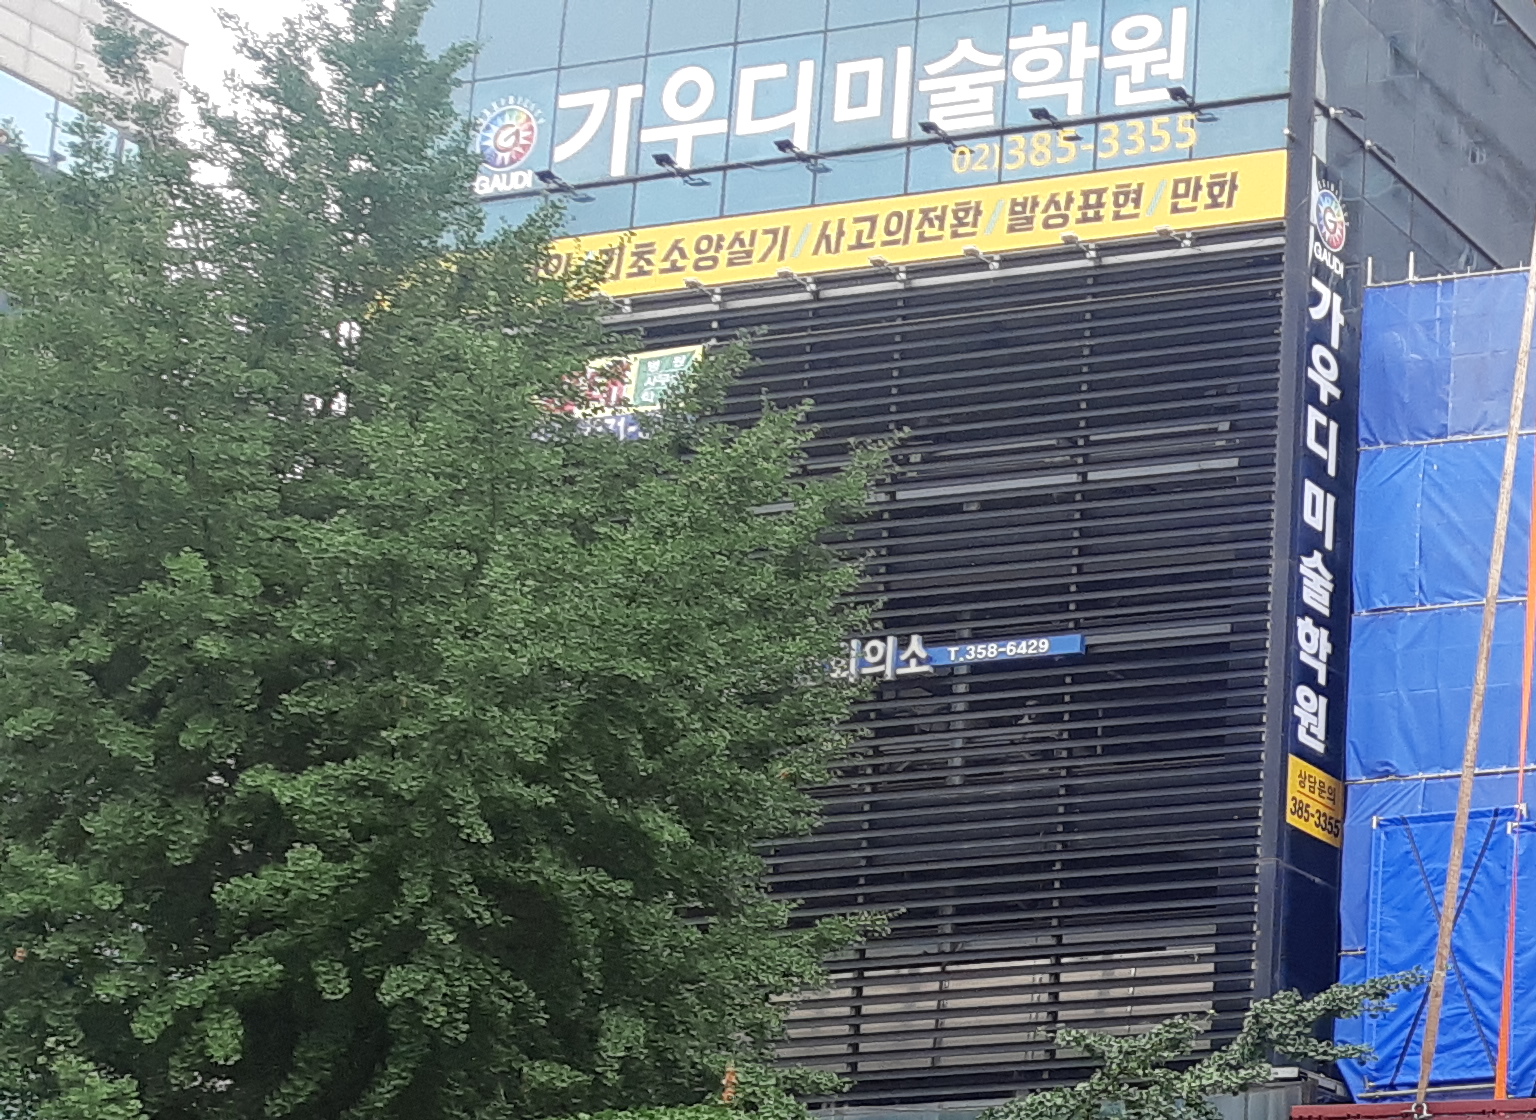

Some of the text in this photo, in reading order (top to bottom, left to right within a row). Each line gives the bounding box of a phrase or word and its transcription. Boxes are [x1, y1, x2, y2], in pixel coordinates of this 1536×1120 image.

[552, 6, 1187, 179] 가우디미술학원
[952, 113, 1197, 172] 02)385-3355
[473, 170, 532, 195] GAUDI
[812, 197, 983, 258] 사고의전환
[1008, 180, 1141, 235] 발상표현
[1169, 171, 1239, 215] 만화
[1313, 241, 1344, 279] GAUDI
[1293, 276, 1345, 754] 가우디미술학원
[947, 638, 1050, 663] T.358-6429
[1297, 768, 1337, 805] 상담문의
[1290, 796, 1340, 839] 385-3355
